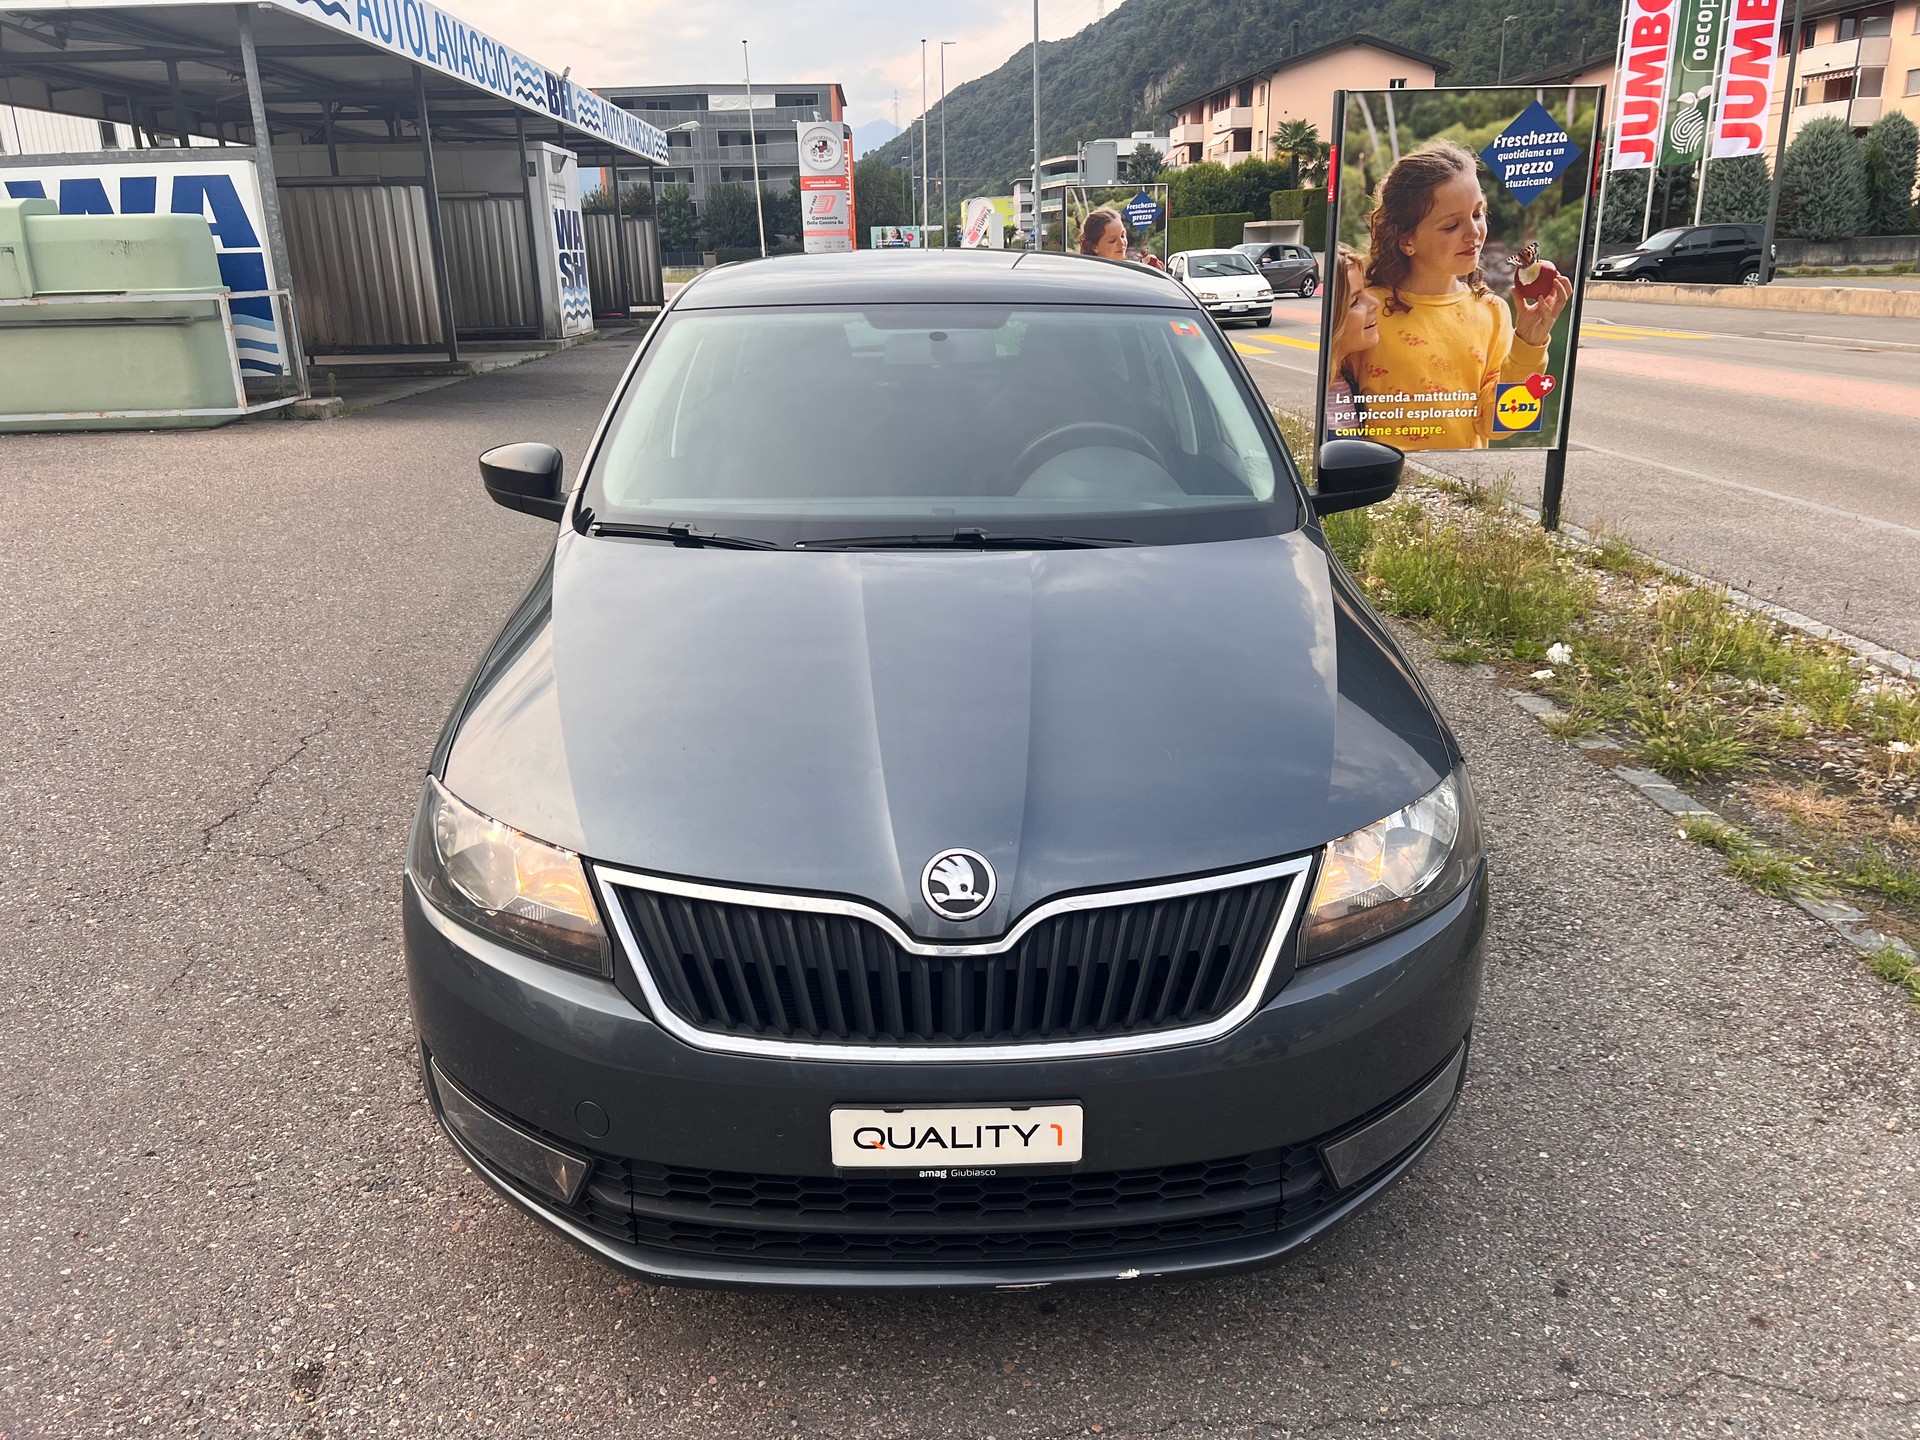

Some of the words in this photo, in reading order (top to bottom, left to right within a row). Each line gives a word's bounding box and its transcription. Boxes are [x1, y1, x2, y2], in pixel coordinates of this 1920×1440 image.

[357, 0, 512, 96] AUTOLAVACCIO
[545, 71, 577, 124] BEL
[601, 102, 656, 157] AUTOLAVACCIO
[1493, 131, 1568, 148] Freschezza
[1497, 149, 1544, 162] quotidiana
[1504, 160, 1553, 180] prezzo
[1505, 177, 1552, 188] stuzzicante
[1127, 202, 1157, 210] Freschezza
[976, 208, 992, 233] STUPPIA
[1132, 214, 1152, 222] prezzo
[1336, 393, 1350, 404] La
[1353, 391, 1410, 403] merenda
[1413, 390, 1477, 402] mattutina
[1335, 411, 1357, 422] per
[1359, 408, 1403, 422] piccoli
[1407, 406, 1478, 421] esploratori
[1335, 425, 1392, 436] conviene
[1395, 425, 1446, 437] sempre.
[853, 1124, 1041, 1150] QUALITY
[1050, 1124, 1063, 1146] 1
[919, 1169, 947, 1179] amag
[950, 1168, 997, 1177] Giubiasco
